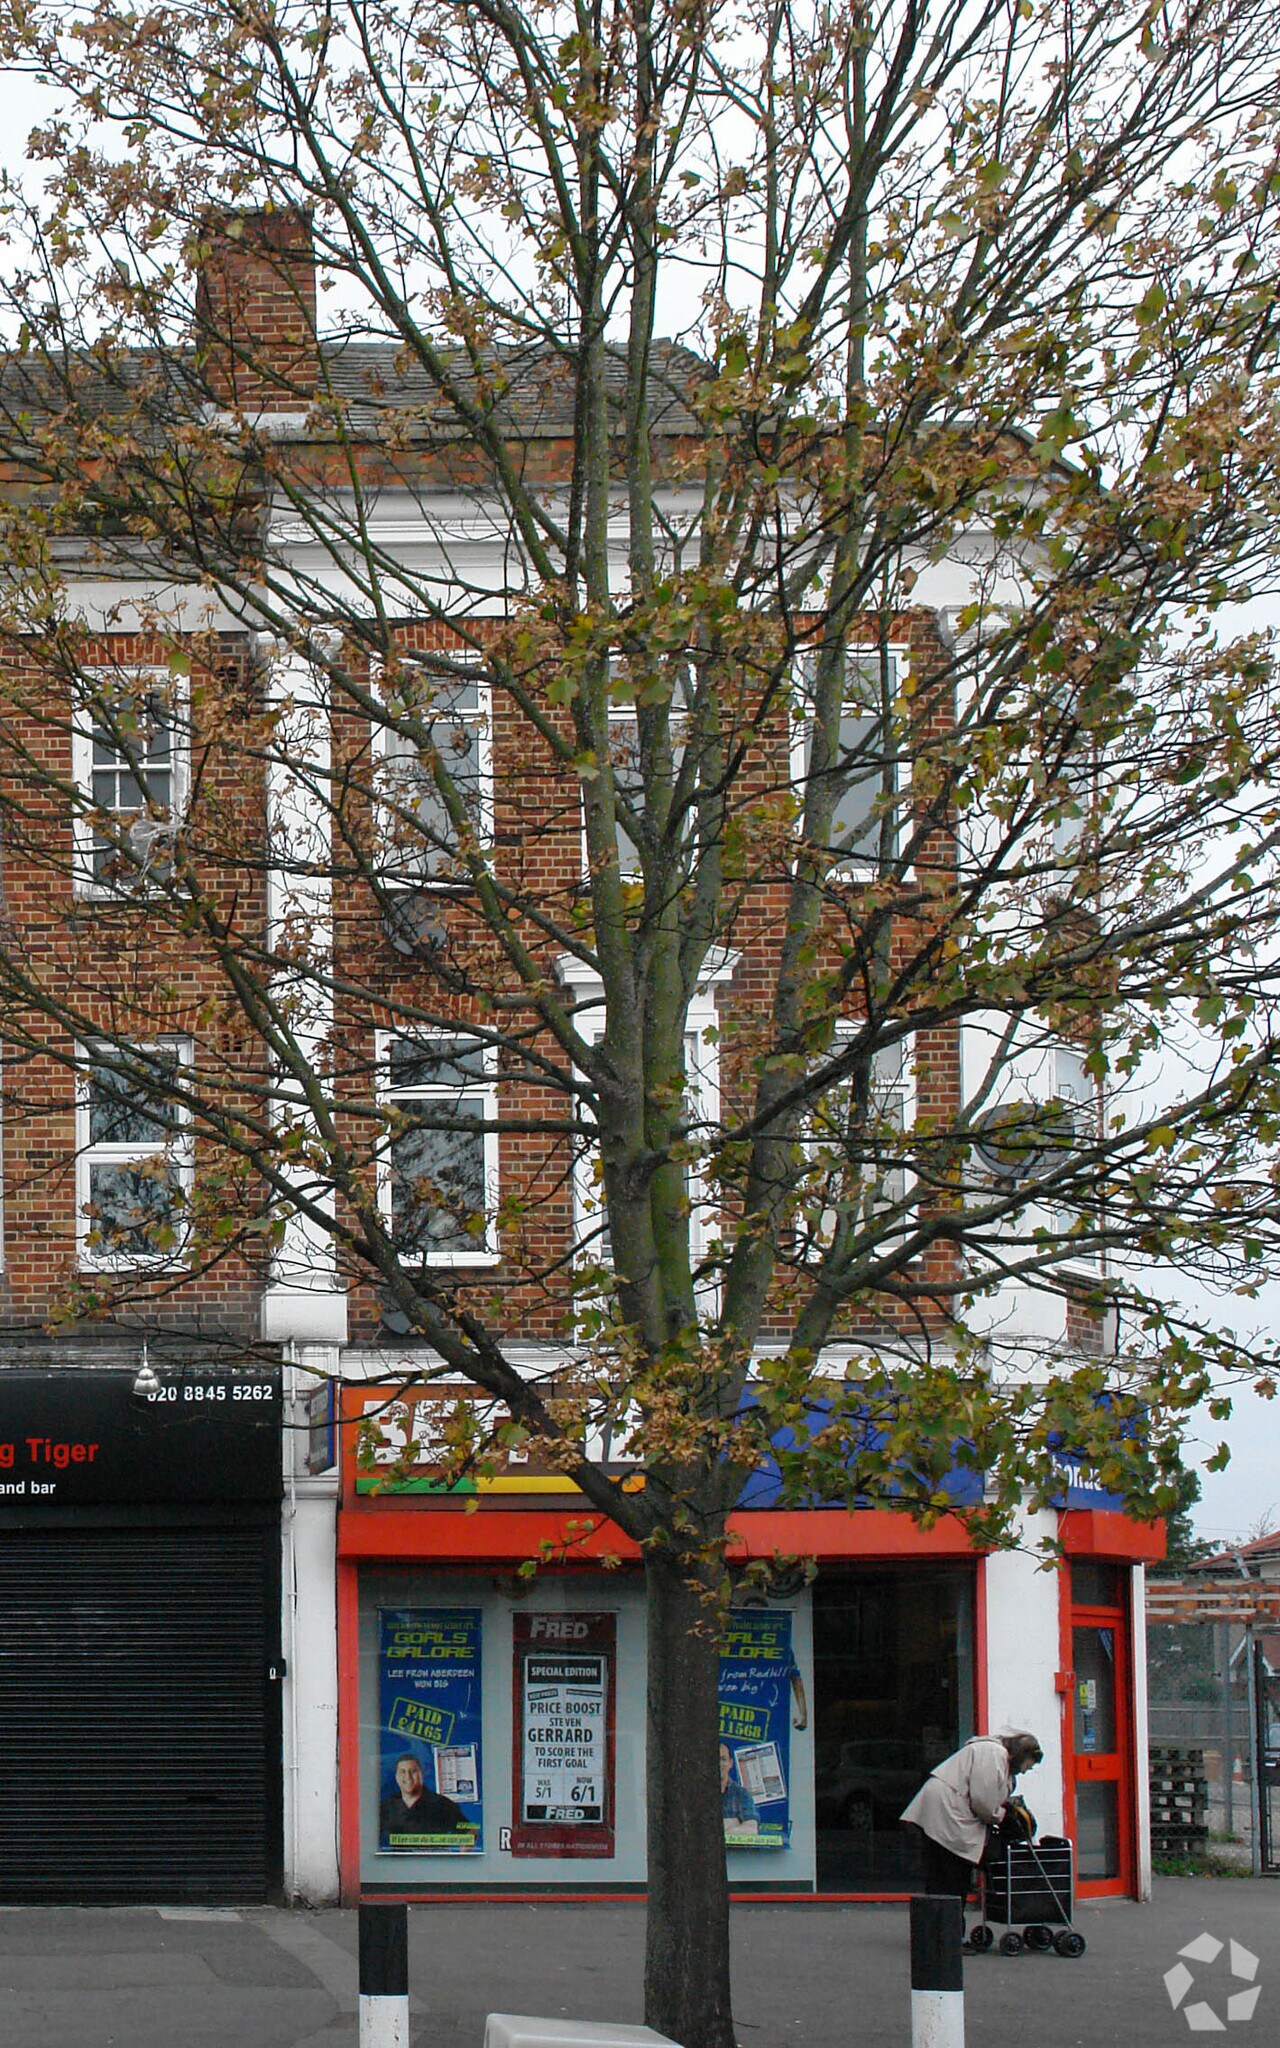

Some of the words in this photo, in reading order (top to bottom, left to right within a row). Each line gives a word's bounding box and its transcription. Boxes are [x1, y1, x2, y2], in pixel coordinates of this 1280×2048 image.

[184, 1385, 226, 1401] 8845
[232, 1385, 273, 1401] 5262
[25, 1437, 99, 1469] Tiger
[0, 1481, 26, 1495] and
[31, 1481, 56, 1495] bar
[529, 1616, 589, 1639] FRED
[394, 1632, 468, 1644] GOALS
[386, 1646, 475, 1659] GALORE
[531, 1666, 564, 1677] SPECIAL
[565, 1667, 598, 1677] EDITION
[405, 1703, 443, 1726] PAID
[530, 1702, 561, 1714] PRICE
[565, 1702, 602, 1714] BOOST
[720, 1704, 755, 1723] PAID
[549, 1717, 582, 1727] STEVEN
[528, 1728, 593, 1743] GERRARD
[535, 1747, 546, 1756] TO
[548, 1747, 575, 1757] SCORE
[577, 1748, 594, 1757] THE
[538, 1759, 562, 1768] FIRST
[565, 1759, 587, 1769] GOAL
[576, 1776, 593, 1784] NOW
[535, 1787, 551, 1798] 5/1
[571, 1785, 595, 1803] 6/1
[545, 1806, 585, 1820] FRED
